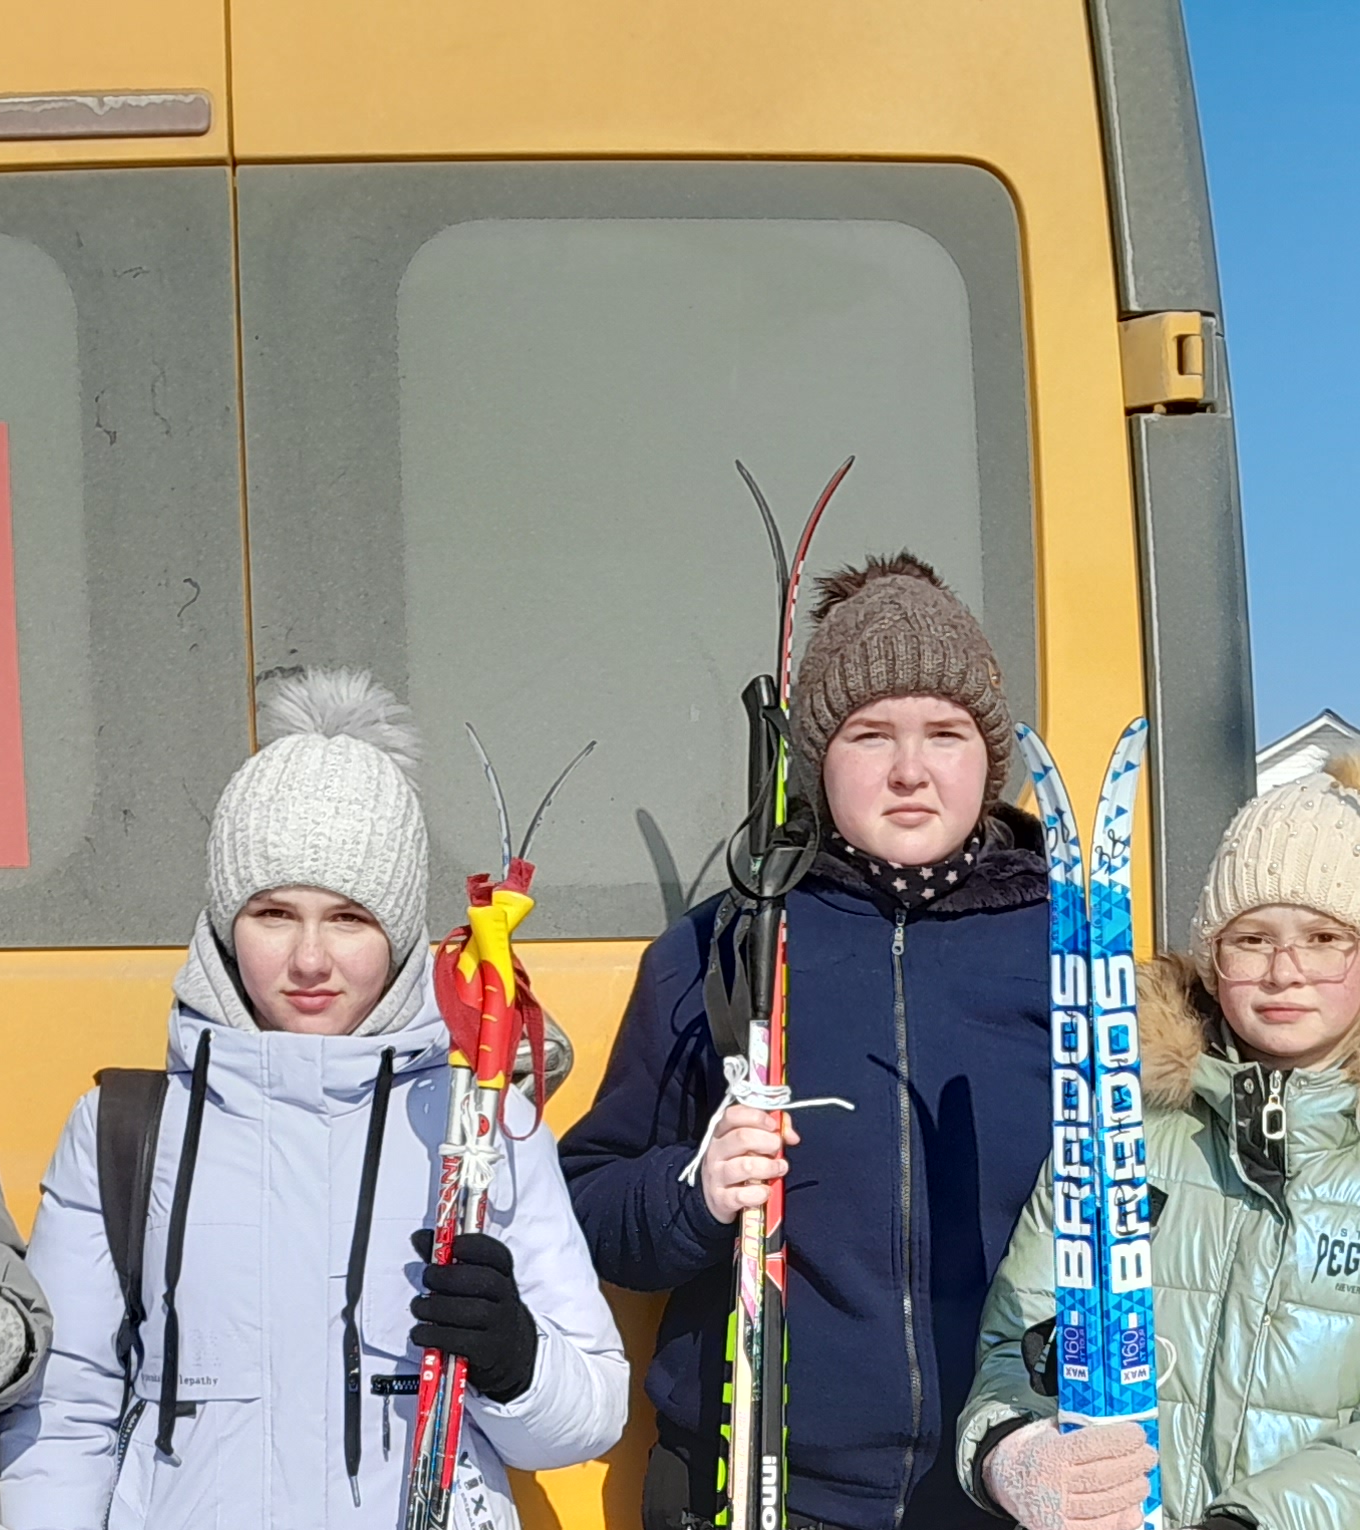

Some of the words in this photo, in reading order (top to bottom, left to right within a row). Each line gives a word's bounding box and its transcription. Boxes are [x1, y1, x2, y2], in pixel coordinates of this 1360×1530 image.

[1051, 953, 1094, 1289] BRADOS
[1094, 953, 1153, 1294] BRADOS
[1335, 1283, 1360, 1295] NEVER
[1063, 1327, 1080, 1361] 160
[1121, 1330, 1139, 1366] 160
[1065, 1366, 1087, 1378] WAX
[1123, 1368, 1147, 1381] WAX
